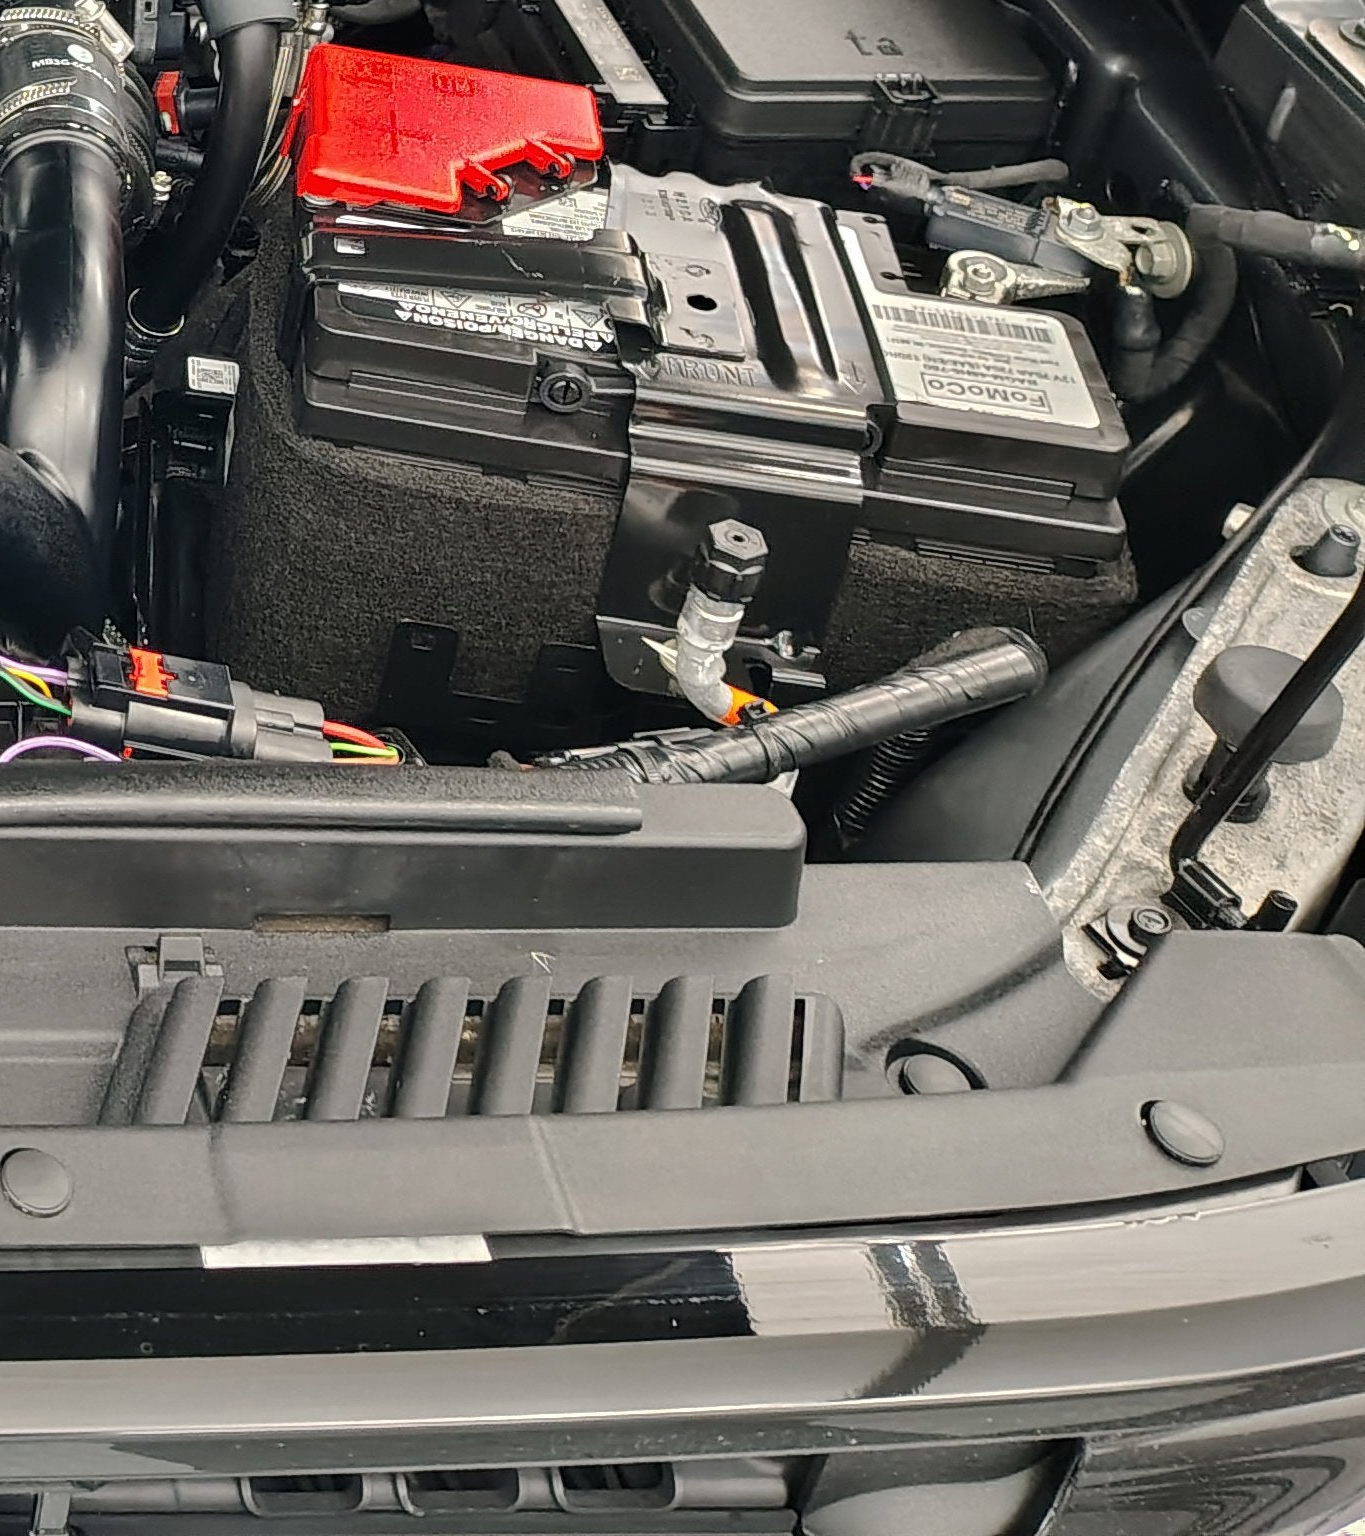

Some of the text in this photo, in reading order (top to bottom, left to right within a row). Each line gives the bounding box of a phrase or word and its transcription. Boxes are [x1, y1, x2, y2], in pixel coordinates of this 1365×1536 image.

[412, 312, 585, 350] DANGER/POISON
[413, 303, 599, 340] PELIGRO/VENENO
[666, 356, 756, 387] FRONT
[927, 379, 1048, 409] FoMoCo
